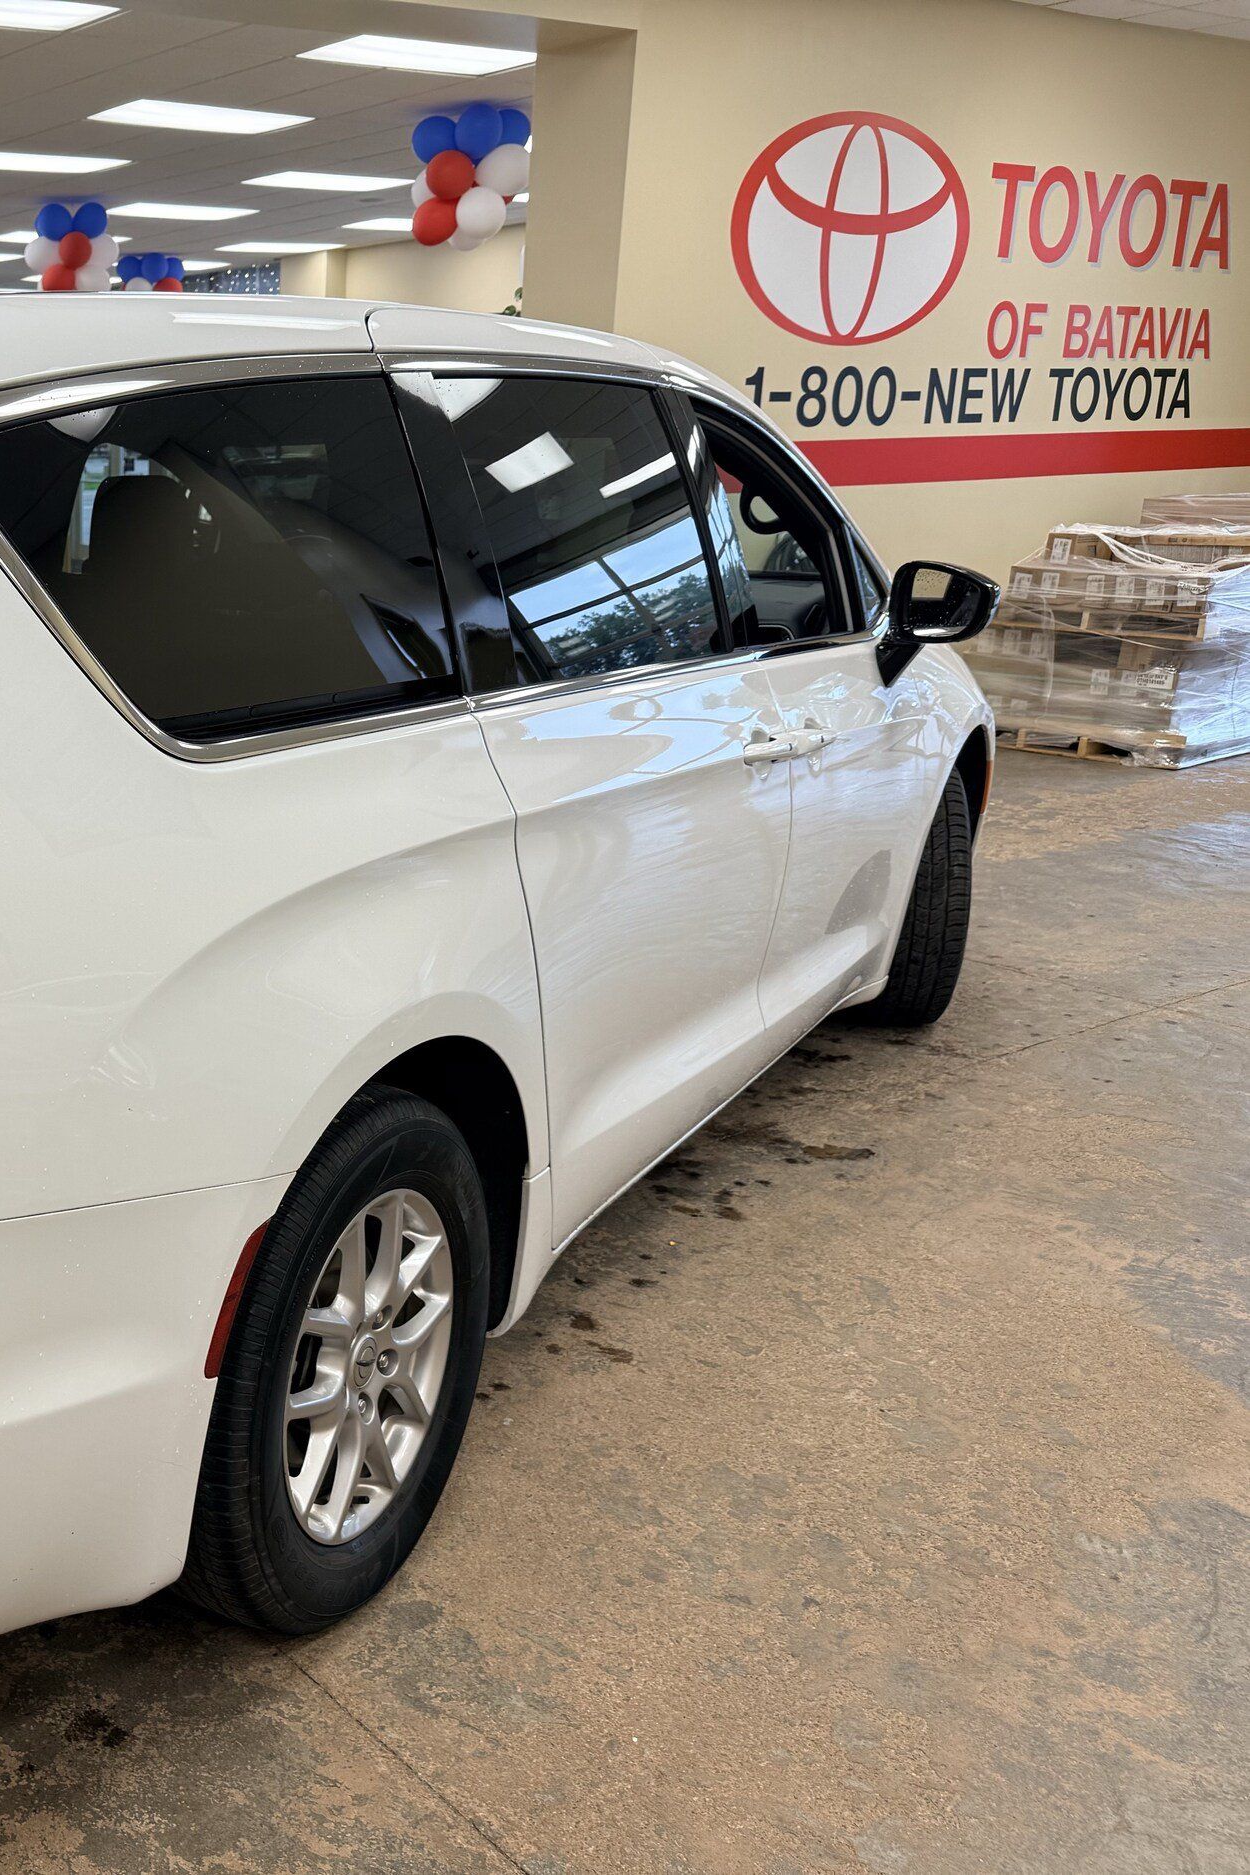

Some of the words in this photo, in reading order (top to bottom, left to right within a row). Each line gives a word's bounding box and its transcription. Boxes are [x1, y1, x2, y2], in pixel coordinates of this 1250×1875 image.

[992, 162, 1230, 271] TOYOTA
[986, 301, 1049, 360] OF
[1062, 304, 1211, 360] BATAVIA
[743, 365, 1031, 427] 1-800-NEW
[1048, 367, 1191, 422] TOYOTA
